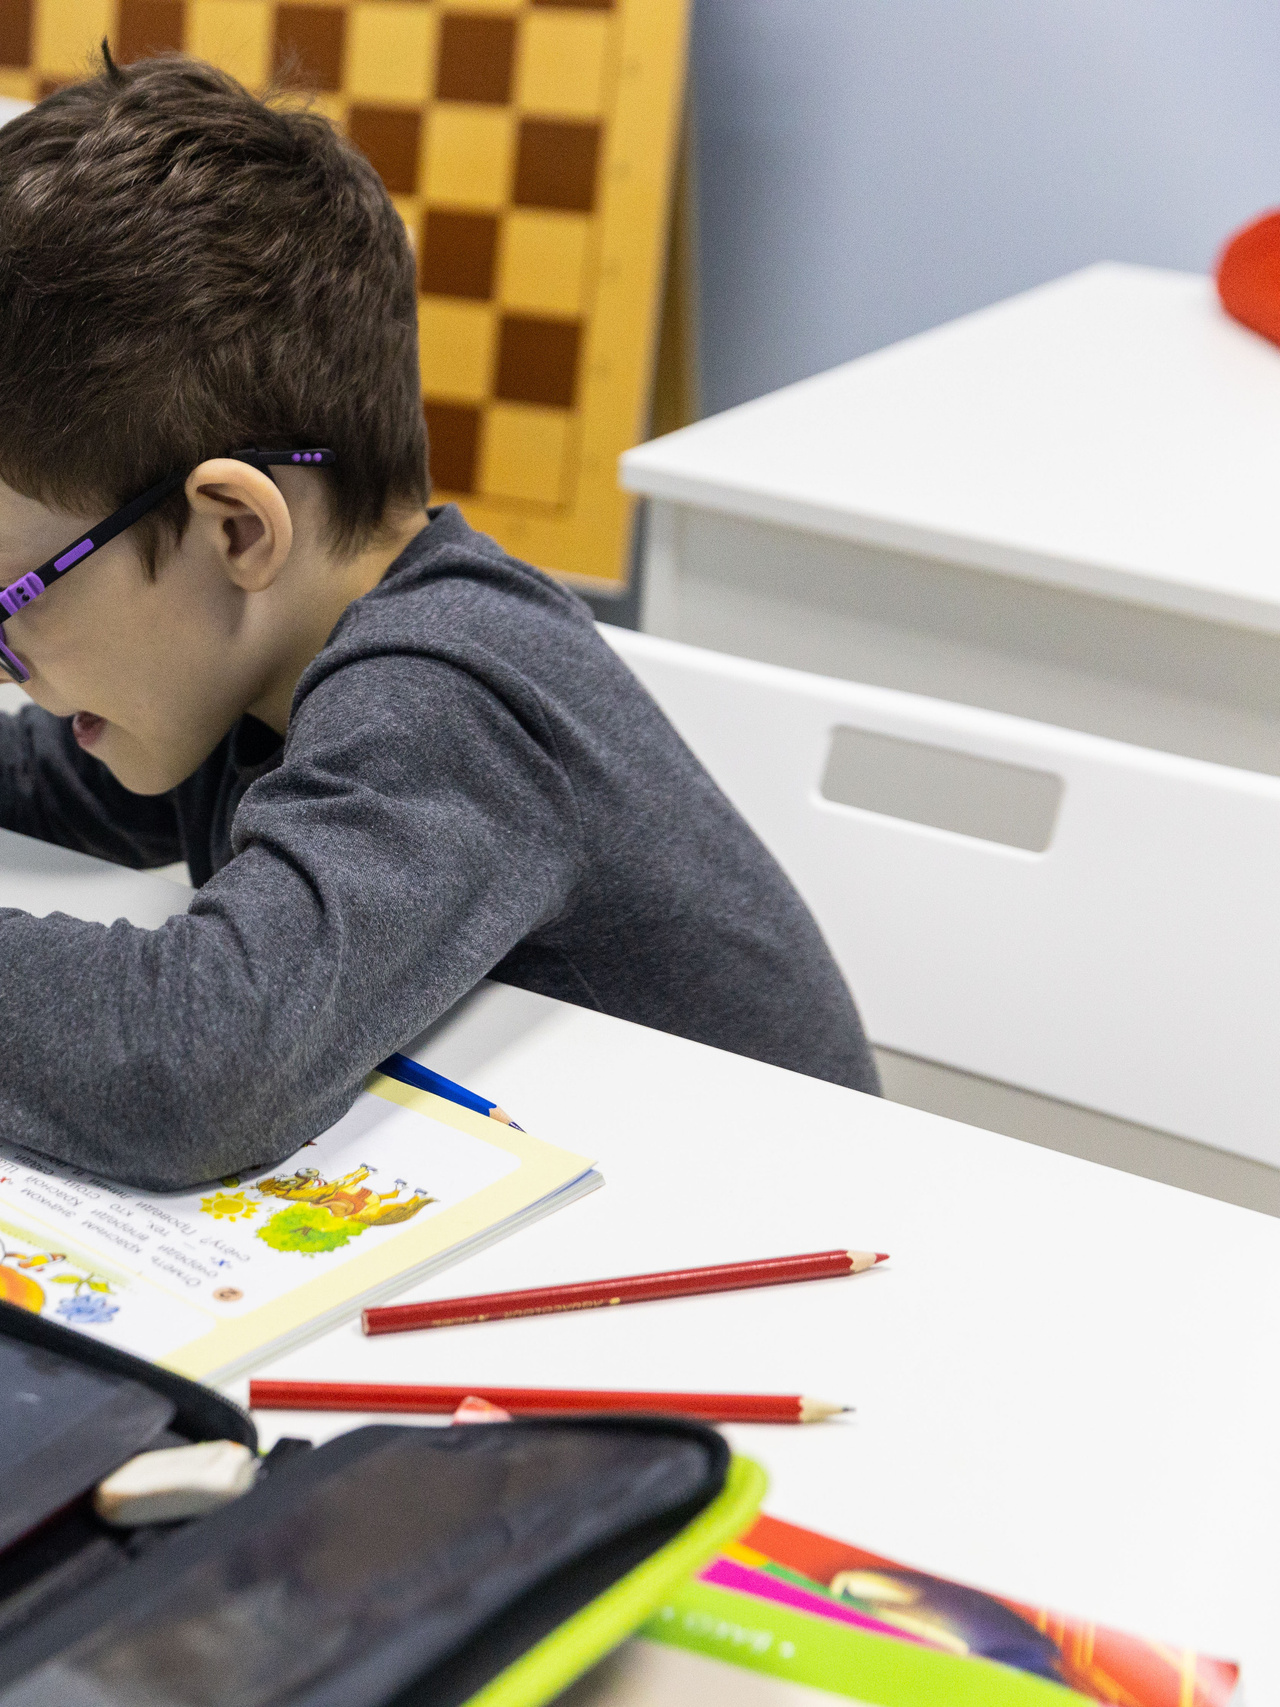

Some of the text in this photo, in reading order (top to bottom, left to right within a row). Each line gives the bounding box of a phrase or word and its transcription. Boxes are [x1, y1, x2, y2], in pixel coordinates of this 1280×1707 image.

[13, 1152, 56, 1176] сзади.
[20, 1187, 73, 1218] значком
[25, 1173, 83, 1207] Красной
[64, 1178, 103, 1201] стоит
[85, 1176, 129, 1199] линии
[90, 1207, 150, 1244] впереди
[109, 1202, 135, 1218] кто
[133, 1200, 197, 1235] Проведи
[82, 1220, 143, 1254] красным
[151, 1255, 202, 1288] Отметь
[158, 1244, 219, 1279] очереди
[216, 1288, 239, 1302] 2
